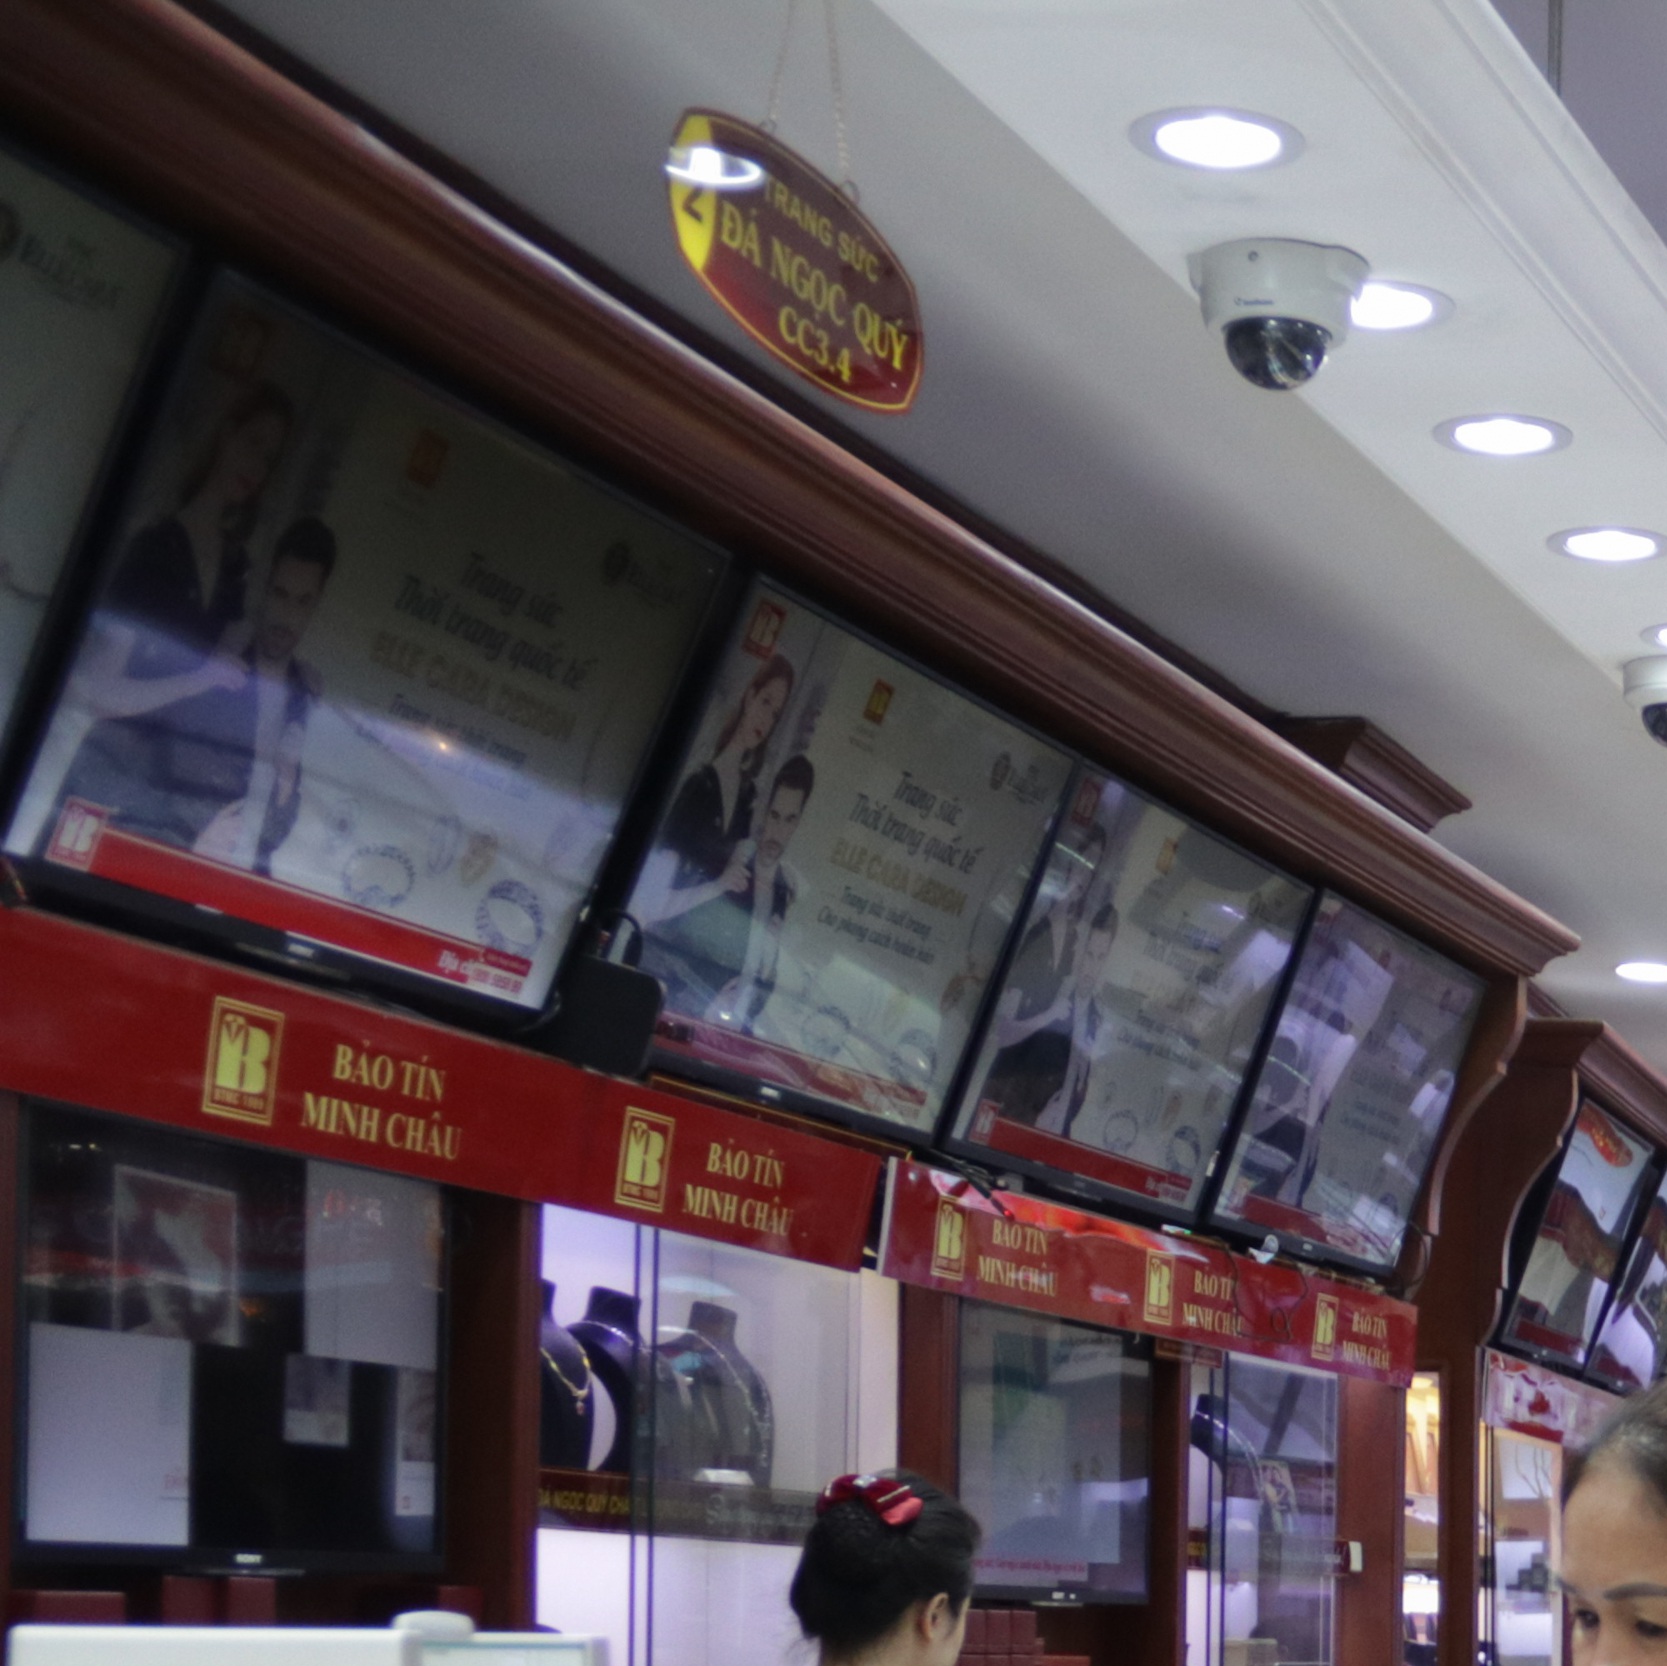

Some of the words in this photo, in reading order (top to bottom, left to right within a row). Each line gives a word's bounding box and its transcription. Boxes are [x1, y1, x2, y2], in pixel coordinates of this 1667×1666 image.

[837, 230, 879, 283] SỨC
[720, 200, 762, 268] ĐÁ
[771, 236, 847, 328] NGỌC
[853, 301, 908, 370] QUÝ
[778, 305, 852, 383] CC3.4
[333, 1038, 394, 1091] BẢO
[401, 1054, 446, 1102] TÍN
[301, 1091, 380, 1144] MINH
[386, 1111, 463, 1161] CHÂU
[706, 1137, 749, 1181] BẢO
[753, 1148, 786, 1190] TÍN
[682, 1183, 739, 1226] MINH
[741, 1196, 795, 1237] CHÂU
[976, 1254, 1014, 1286] MINH
[1019, 1261, 1059, 1297] CHÂU
[1182, 1302, 1213, 1332] MINH
[1352, 1307, 1371, 1336] BẢO
[1372, 1312, 1388, 1340] TÍN
[1342, 1340, 1367, 1364] MINH
